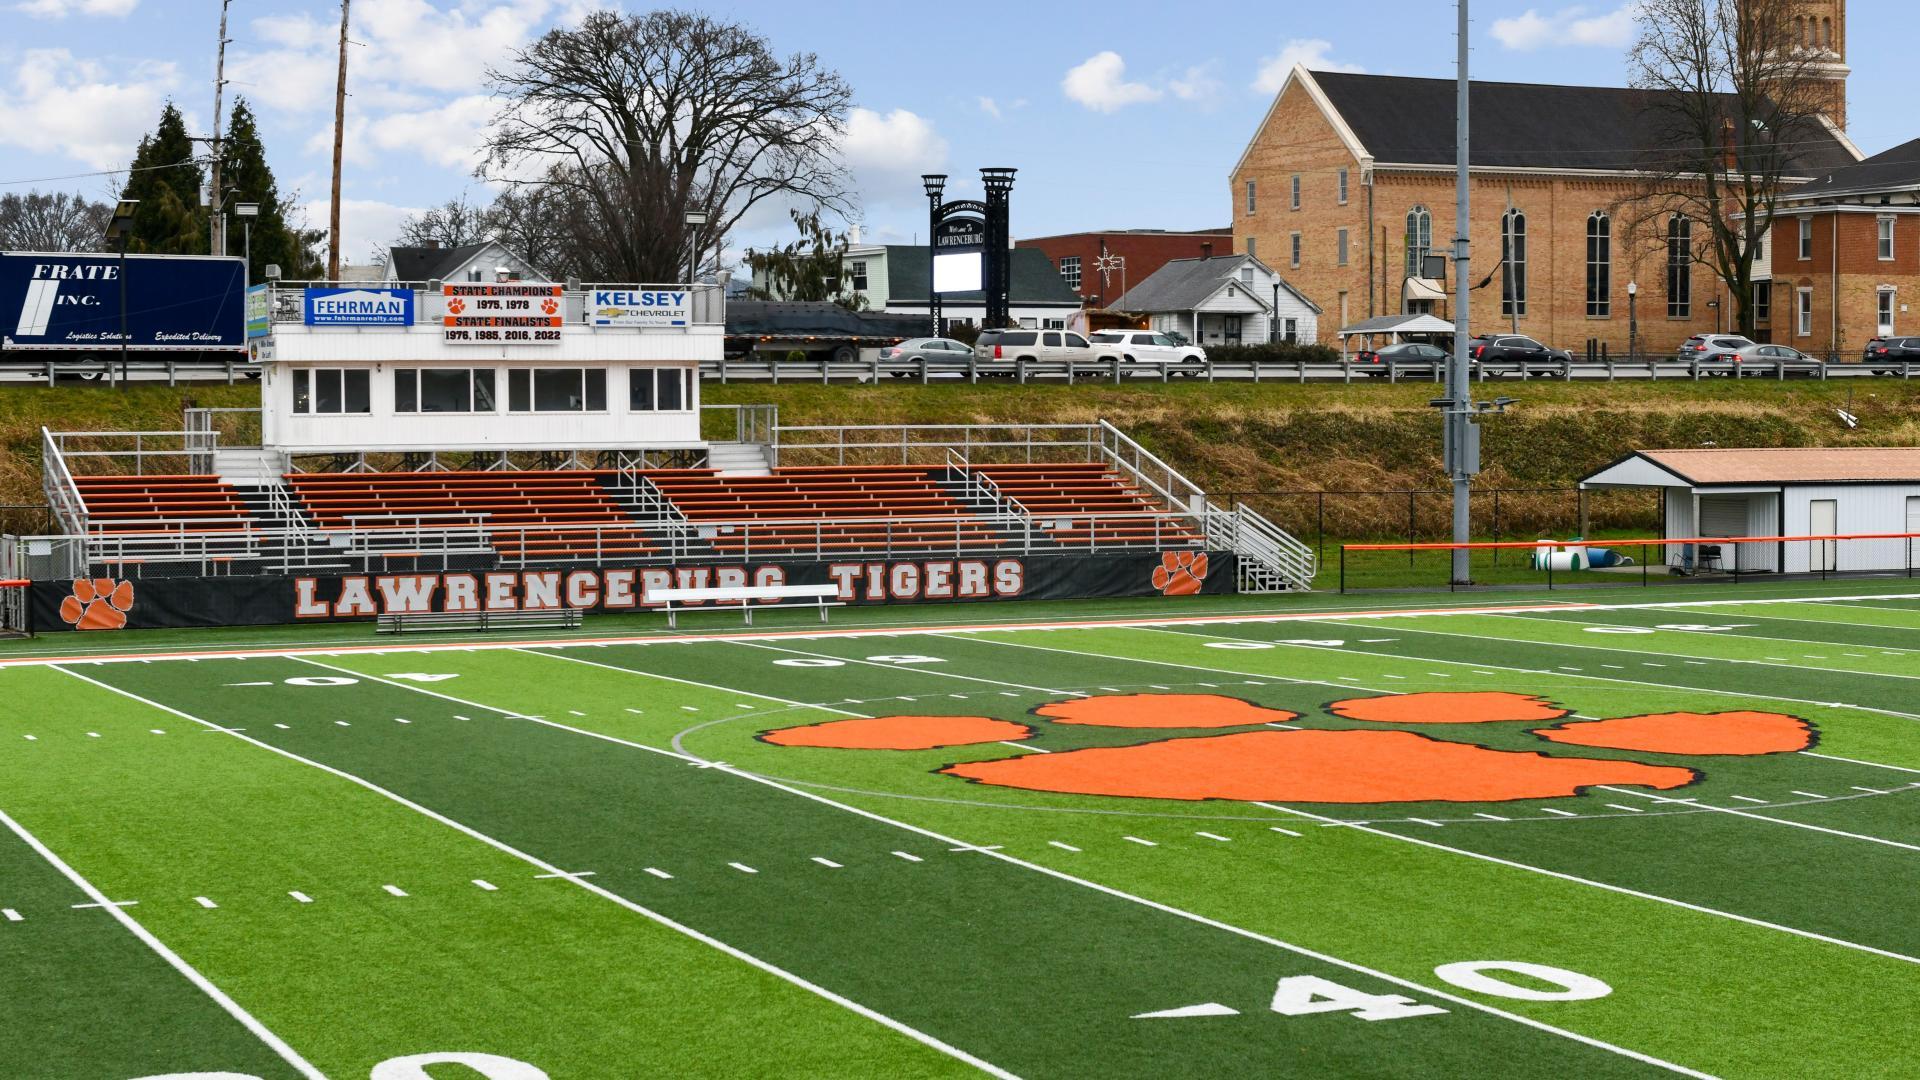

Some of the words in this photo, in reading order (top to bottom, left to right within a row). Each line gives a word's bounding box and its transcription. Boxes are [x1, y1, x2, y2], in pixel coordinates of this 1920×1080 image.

[937, 233, 983, 246] LAWRENCEBURG
[32, 264, 120, 280] FRATE
[452, 286, 488, 296] STATE
[491, 286, 554, 297] CHAMPIONS
[56, 294, 101, 306] INC.
[596, 291, 685, 306] KELSEY
[317, 300, 400, 314] FEHRMAN
[477, 300, 503, 310] 1975,
[506, 300, 530, 310] 1978
[630, 309, 686, 317] CHEVROLET
[455, 316, 491, 327] STATE
[494, 316, 551, 327] FINALISTS
[65, 331, 98, 341] Logistics
[99, 331, 133, 341] Solutins
[154, 331, 191, 342] Expedited
[192, 332, 223, 343] Delivery
[445, 330, 472, 341] 1976,
[475, 330, 502, 341] 1985,
[505, 330, 532, 341] 2016,
[534, 330, 561, 340] 2022
[295, 565, 786, 618] LAWRENCEBURG
[829, 559, 1024, 600] TIGERS
